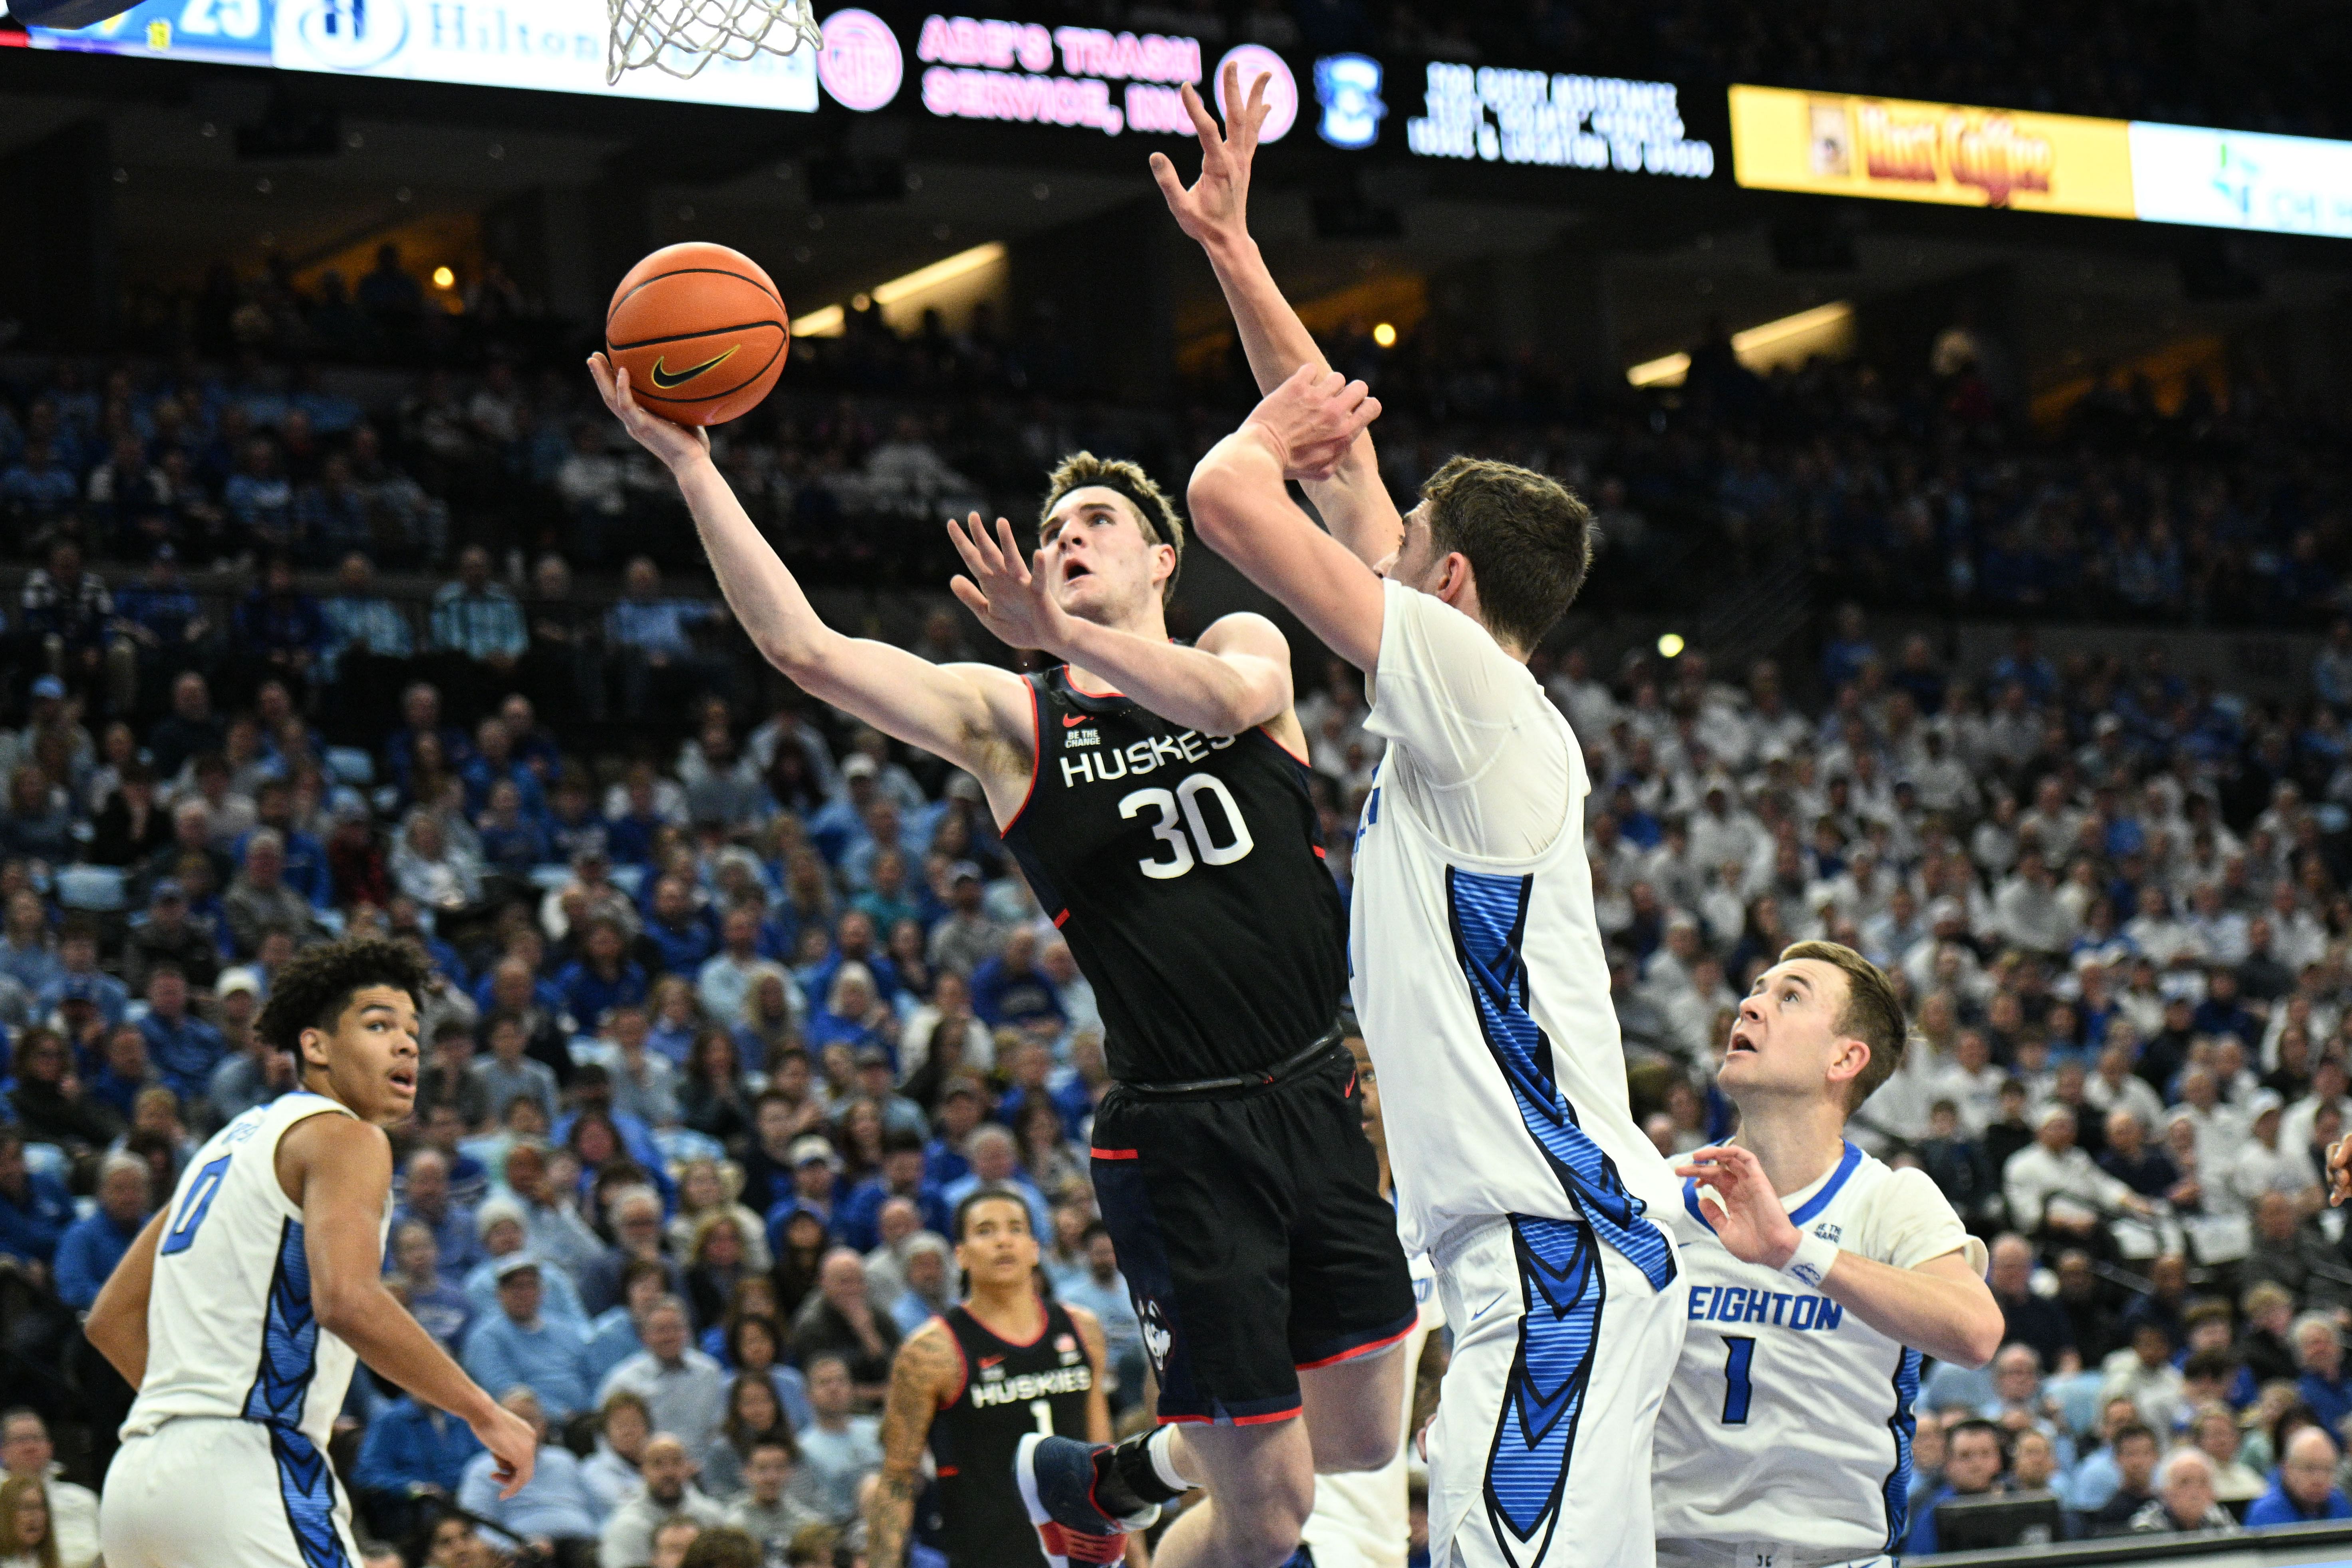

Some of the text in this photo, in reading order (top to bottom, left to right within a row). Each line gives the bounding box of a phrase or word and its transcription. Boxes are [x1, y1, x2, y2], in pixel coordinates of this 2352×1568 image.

[429, 2, 600, 62] Hilton
[917, 14, 1202, 84] ABE'S TRASH
[922, 66, 1123, 136] SERVICE,
[1065, 737, 1101, 748] CHANGE
[1067, 729, 1098, 740] BE THE
[1118, 773, 1254, 879] 30
[161, 1154, 232, 1255] 0
[970, 1365, 1091, 1409] HUSKIES
[1721, 1335, 1756, 1425] 1
